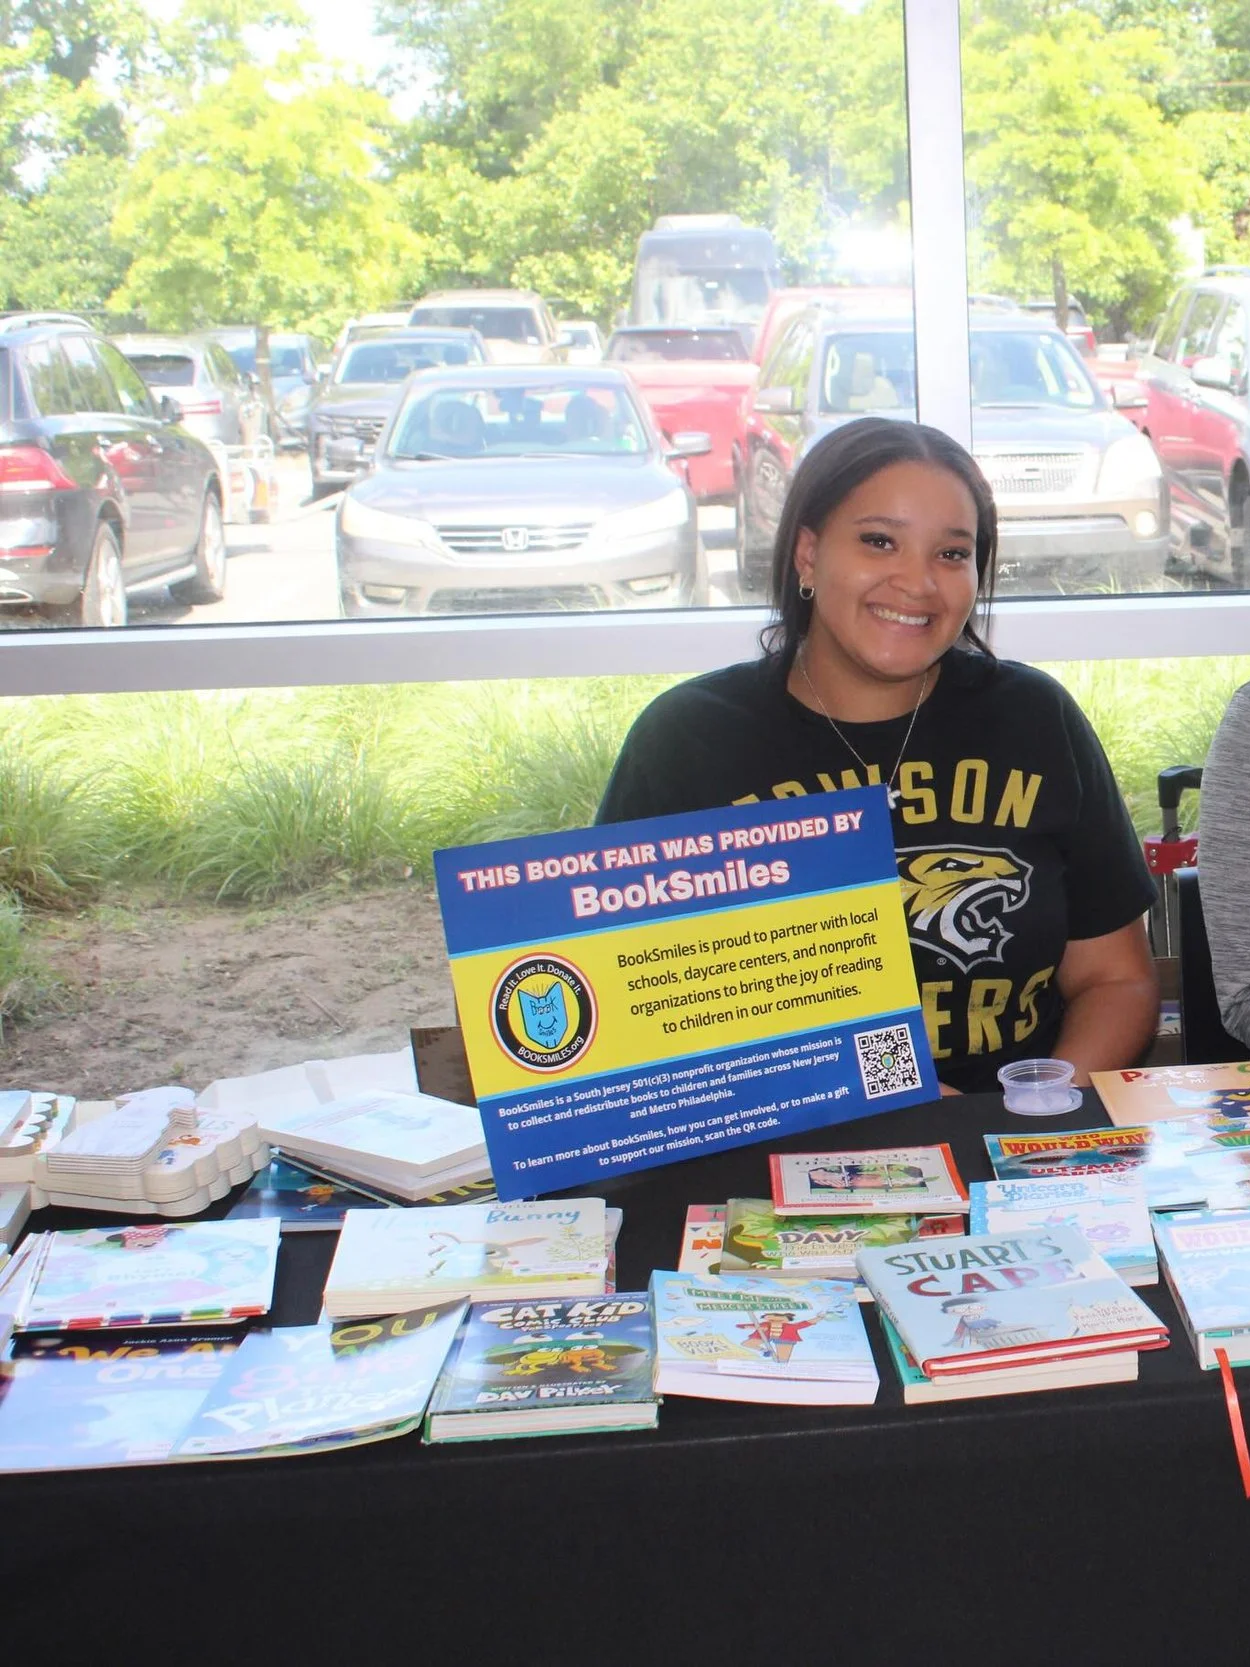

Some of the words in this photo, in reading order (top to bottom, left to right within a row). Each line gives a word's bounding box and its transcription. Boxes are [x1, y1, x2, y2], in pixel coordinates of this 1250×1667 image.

[732, 759, 1043, 828] SON
[457, 863, 521, 892] THIS
[524, 851, 600, 882] BOOK
[600, 842, 658, 870] FAIR
[659, 834, 714, 860] WAS
[717, 816, 829, 852] PROVIDED
[832, 810, 863, 833] BY
[570, 859, 790, 919] BookSmiles
[617, 943, 696, 968] BookSmiles
[698, 939, 710, 953] is
[712, 931, 751, 954] proud
[753, 931, 767, 943] to
[770, 922, 817, 944] partner
[819, 914, 848, 930] with
[849, 907, 878, 925] local
[627, 970, 681, 991] schools,
[683, 961, 736, 981] daycare
[739, 951, 790, 970] centers,
[792, 942, 817, 960] and
[819, 932, 877, 955] nonprofit
[499, 989, 512, 1010] Read
[507, 979, 519, 990] It.
[516, 965, 536, 980] Love
[537, 963, 546, 973] It.
[547, 964, 576, 987] Donate
[574, 984, 582, 995] It.
[630, 988, 721, 1017] organizations
[723, 985, 737, 997] to
[739, 978, 774, 994] bring
[775, 972, 797, 987] the
[799, 969, 818, 986] joy
[820, 962, 833, 978] of
[835, 956, 883, 975] reading
[662, 1022, 677, 1034] to
[679, 1010, 734, 1030] children
[735, 1006, 749, 1019] in
[751, 1002, 773, 1016] our
[776, 984, 861, 1011] communities.
[518, 1036, 585, 1064] BOOKSMILES.org
[498, 1099, 555, 1117] BookSmiles
[555, 1096, 564, 1105] is
[565, 1095, 572, 1103] a
[573, 1087, 601, 1101] South
[602, 1082, 631, 1097] Jersey
[632, 1073, 670, 1089] 501(c)(3)
[671, 1063, 714, 1080] nonprofit
[715, 1053, 770, 1071] organization
[770, 1047, 799, 1058] whose
[800, 1039, 833, 1052] mission
[834, 1036, 842, 1045] is
[507, 1122, 519, 1130] to
[520, 1114, 553, 1128] collect
[554, 1108, 573, 1120] and
[574, 1098, 629, 1116] redistribute
[630, 1091, 658, 1104] books
[659, 1089, 670, 1097] to
[671, 1080, 708, 1095] children
[709, 1074, 726, 1086] and
[727, 1068, 763, 1082] families
[763, 1062, 791, 1074] across
[792, 1057, 812, 1068] New
[813, 1052, 839, 1066] Jersey
[1120, 1069, 1205, 1084] Pete
[630, 1106, 648, 1118] and
[648, 1102, 677, 1114] Metro
[677, 1088, 735, 1108] Philadelphia.
[513, 1161, 526, 1170] To
[527, 1155, 553, 1167] learn
[555, 1149, 581, 1161] more
[582, 1141, 610, 1155] about
[611, 1130, 666, 1148] BookSmiles,
[667, 1124, 687, 1135] how
[688, 1120, 705, 1133] you
[706, 1116, 723, 1126] can
[723, 1112, 739, 1124] get
[739, 1102, 779, 1119] involved,
[780, 1101, 790, 1109] or
[790, 1098, 801, 1107] to
[802, 1092, 826, 1104] make
[827, 1091, 833, 1099] a
[834, 1086, 849, 1099] gift
[598, 1157, 609, 1166] to
[610, 1148, 647, 1163] support
[648, 1144, 664, 1154] our
[666, 1136, 703, 1150] mission,
[704, 1130, 725, 1141] scan
[726, 1126, 742, 1136] the
[742, 1122, 756, 1133] QR
[757, 1117, 780, 1129] code.
[1058, 1133, 1101, 1142] WHO
[1004, 1140, 1092, 1156] WOULD
[997, 1182, 1089, 1193] Unicorn
[1003, 1191, 1089, 1200] Diaries
[486, 1209, 582, 1225] Bunny
[778, 1230, 869, 1245] DAVY
[885, 1235, 1064, 1276] STUART'S
[906, 1258, 1086, 1297] CAPE
[689, 1288, 737, 1300] MEET
[739, 1292, 764, 1303] ME
[698, 1302, 756, 1312] MERCER
[757, 1301, 807, 1311] STREET
[480, 1302, 563, 1323] CAT
[569, 1315, 622, 1324] CLUB
[277, 1312, 438, 1352] YOU
[58, 1345, 161, 1365] We
[96, 1363, 224, 1383] One
[476, 1390, 534, 1404] DAV
